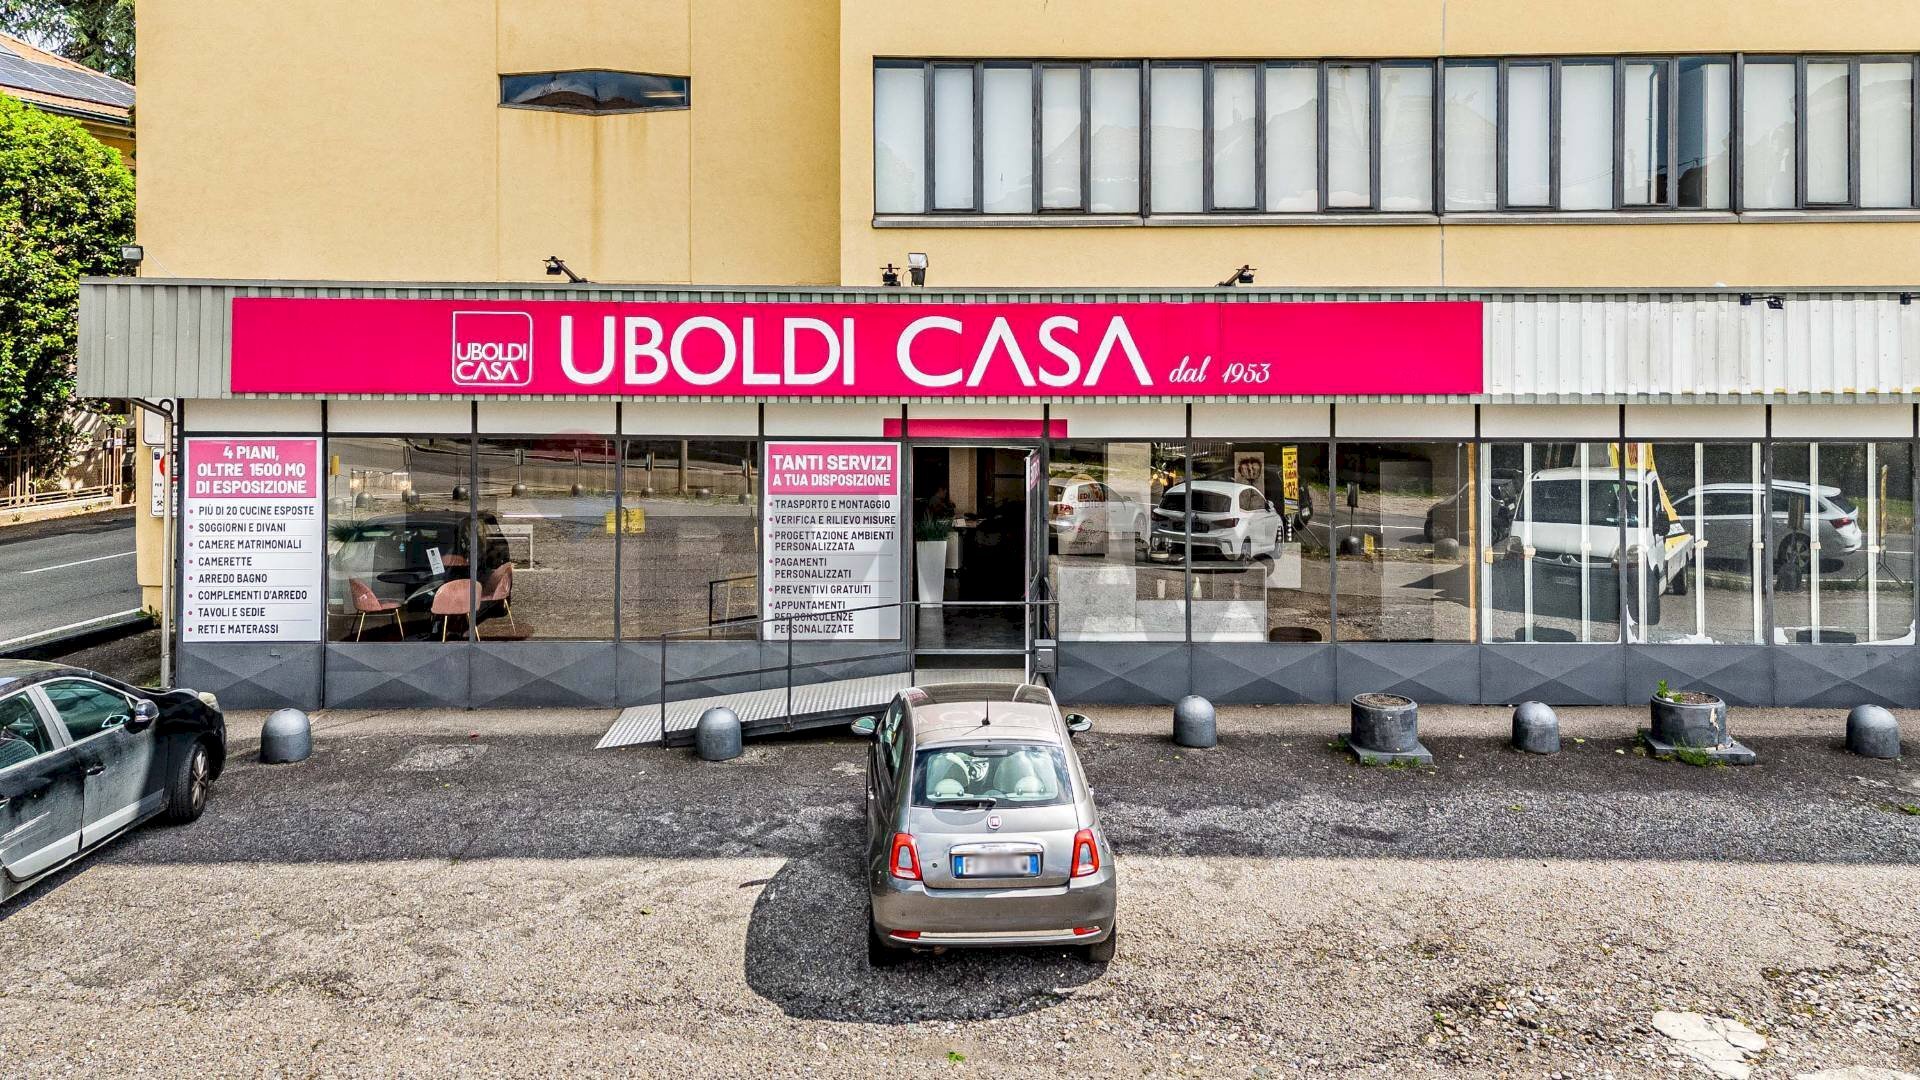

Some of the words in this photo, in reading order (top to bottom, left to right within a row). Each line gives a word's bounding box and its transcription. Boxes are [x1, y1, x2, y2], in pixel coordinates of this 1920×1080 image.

[456, 342, 527, 362] UBOLDI
[560, 315, 855, 385] UBOLDI
[896, 315, 1154, 387] CASA
[456, 362, 519, 381] CASA
[1168, 355, 1212, 384] dal
[1221, 362, 1272, 384] 1953
[223, 446, 233, 459] 4
[237, 446, 279, 461] PIANI,
[772, 455, 822, 471] TANTI
[827, 455, 892, 471] SERVIZI
[198, 463, 243, 476] OLTRE
[249, 463, 282, 477] 1500
[773, 474, 782, 486] A
[784, 474, 808, 486] TUA
[811, 474, 890, 486] DISPOSIZIONE
[196, 481, 210, 494] DI
[213, 480, 307, 494] ESPOSIZIONE
[775, 500, 829, 509] TRASPORTO
[831, 500, 836, 508] E
[839, 500, 890, 509] MONTAGGIO
[215, 507, 224, 515] DI
[226, 507, 237, 515] 20
[240, 506, 271, 515] CUCINE
[274, 506, 314, 515] ESPOSTE
[775, 516, 816, 524] VERIFICA
[818, 516, 823, 524] E
[826, 516, 861, 524] RILIEVO
[863, 516, 896, 524] MISURE
[198, 523, 246, 532] SOGGIORNI
[249, 524, 254, 532] E
[256, 523, 286, 532] DIVANI
[775, 531, 848, 540] PROGETTAZIONE
[851, 531, 894, 540] AMBIENTI
[198, 540, 235, 549] CAMERE
[238, 540, 302, 549] MATRIMONIALI
[775, 542, 855, 551] PERSONALIZZATA
[198, 557, 252, 566] CAMERETTE
[775, 558, 827, 566] PAGAMENTI
[198, 574, 234, 583] ARREDO
[237, 574, 267, 583] BAGNO
[775, 570, 851, 579] PERSONALIZZATI
[775, 585, 828, 594] PREVENTIVI
[830, 585, 871, 594] GRATUITI
[198, 591, 261, 600] COMPLEMENTI
[264, 591, 307, 599] D'ARREDO
[775, 601, 845, 610] APPUNTAMENTI
[198, 608, 229, 617] TAVOLI
[232, 608, 237, 616] E
[240, 608, 266, 616] SEDIE
[198, 625, 217, 634] RETI
[220, 625, 225, 633] E
[228, 625, 278, 634] MATERASSI
[775, 625, 854, 633] PERSONALIZZATE
